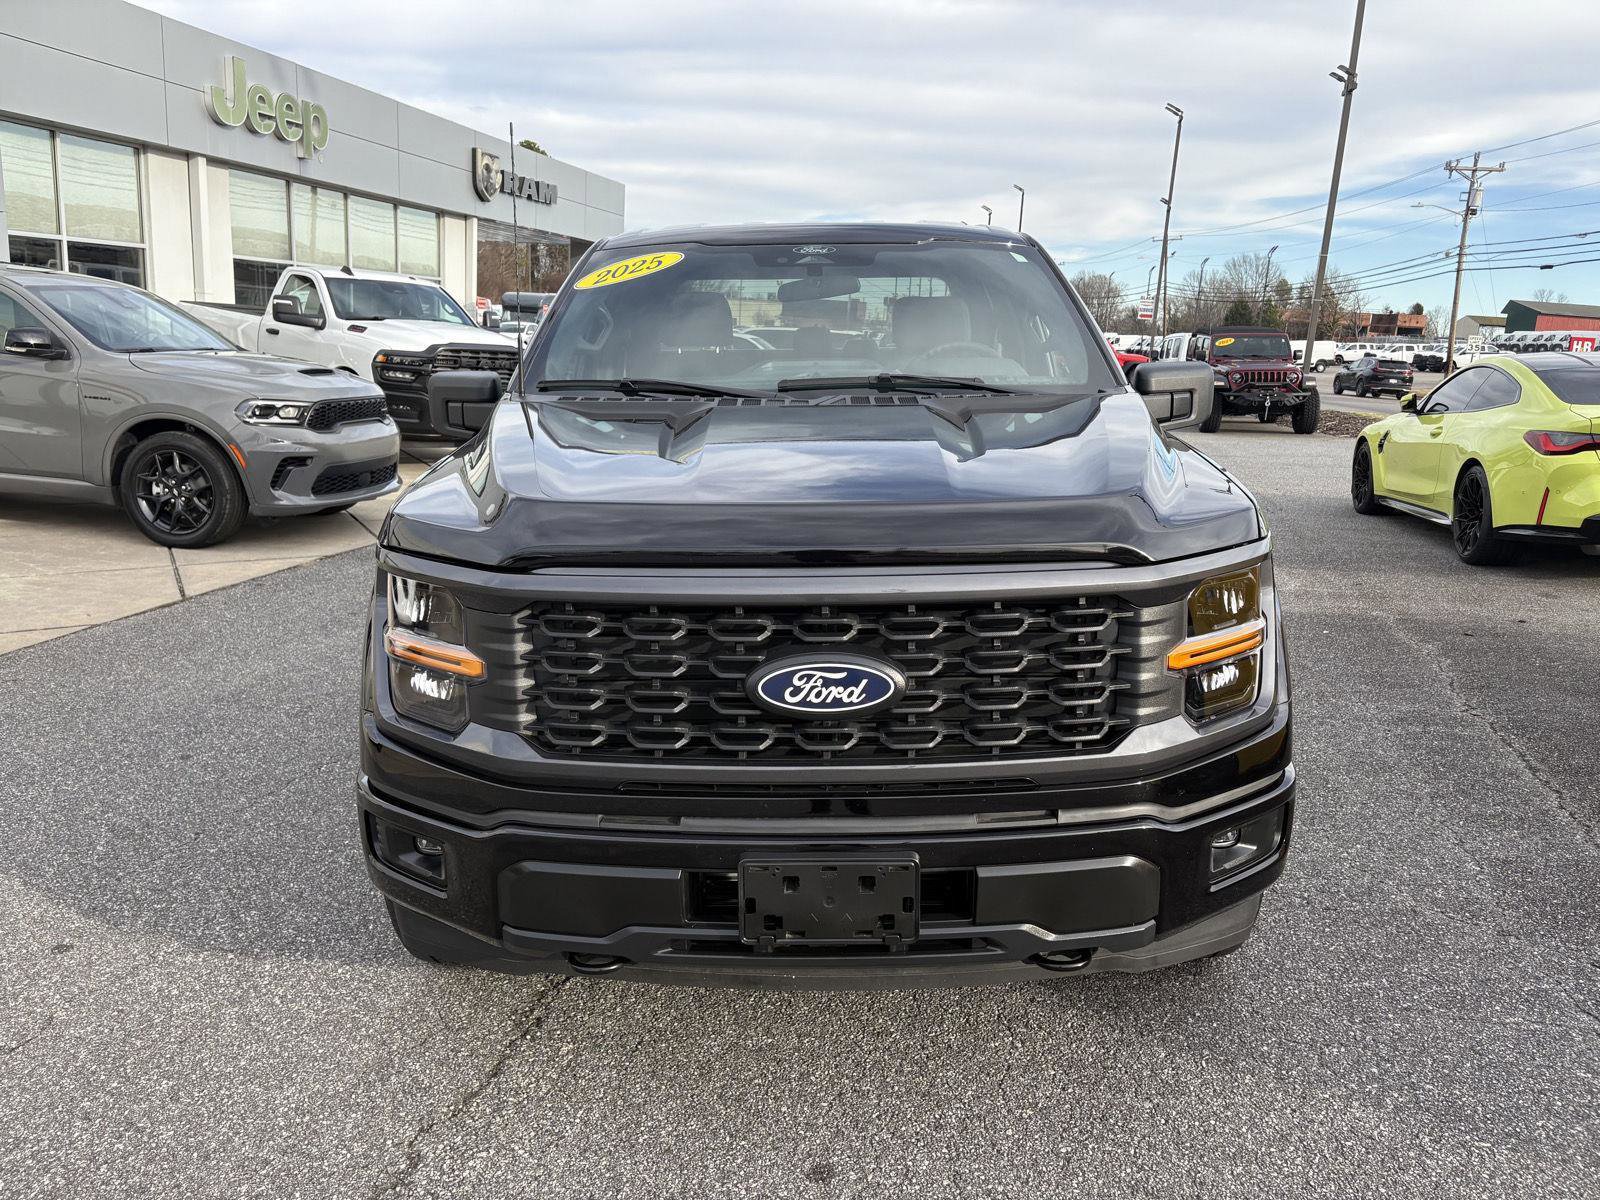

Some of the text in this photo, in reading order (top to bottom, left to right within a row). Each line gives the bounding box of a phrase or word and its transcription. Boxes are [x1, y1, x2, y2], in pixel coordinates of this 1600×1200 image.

[204, 56, 329, 160] Jeep
[500, 170, 558, 204] RAM
[592, 255, 666, 286] 2025
[1467, 344, 1480, 352] 35
[784, 670, 868, 704] Ford
